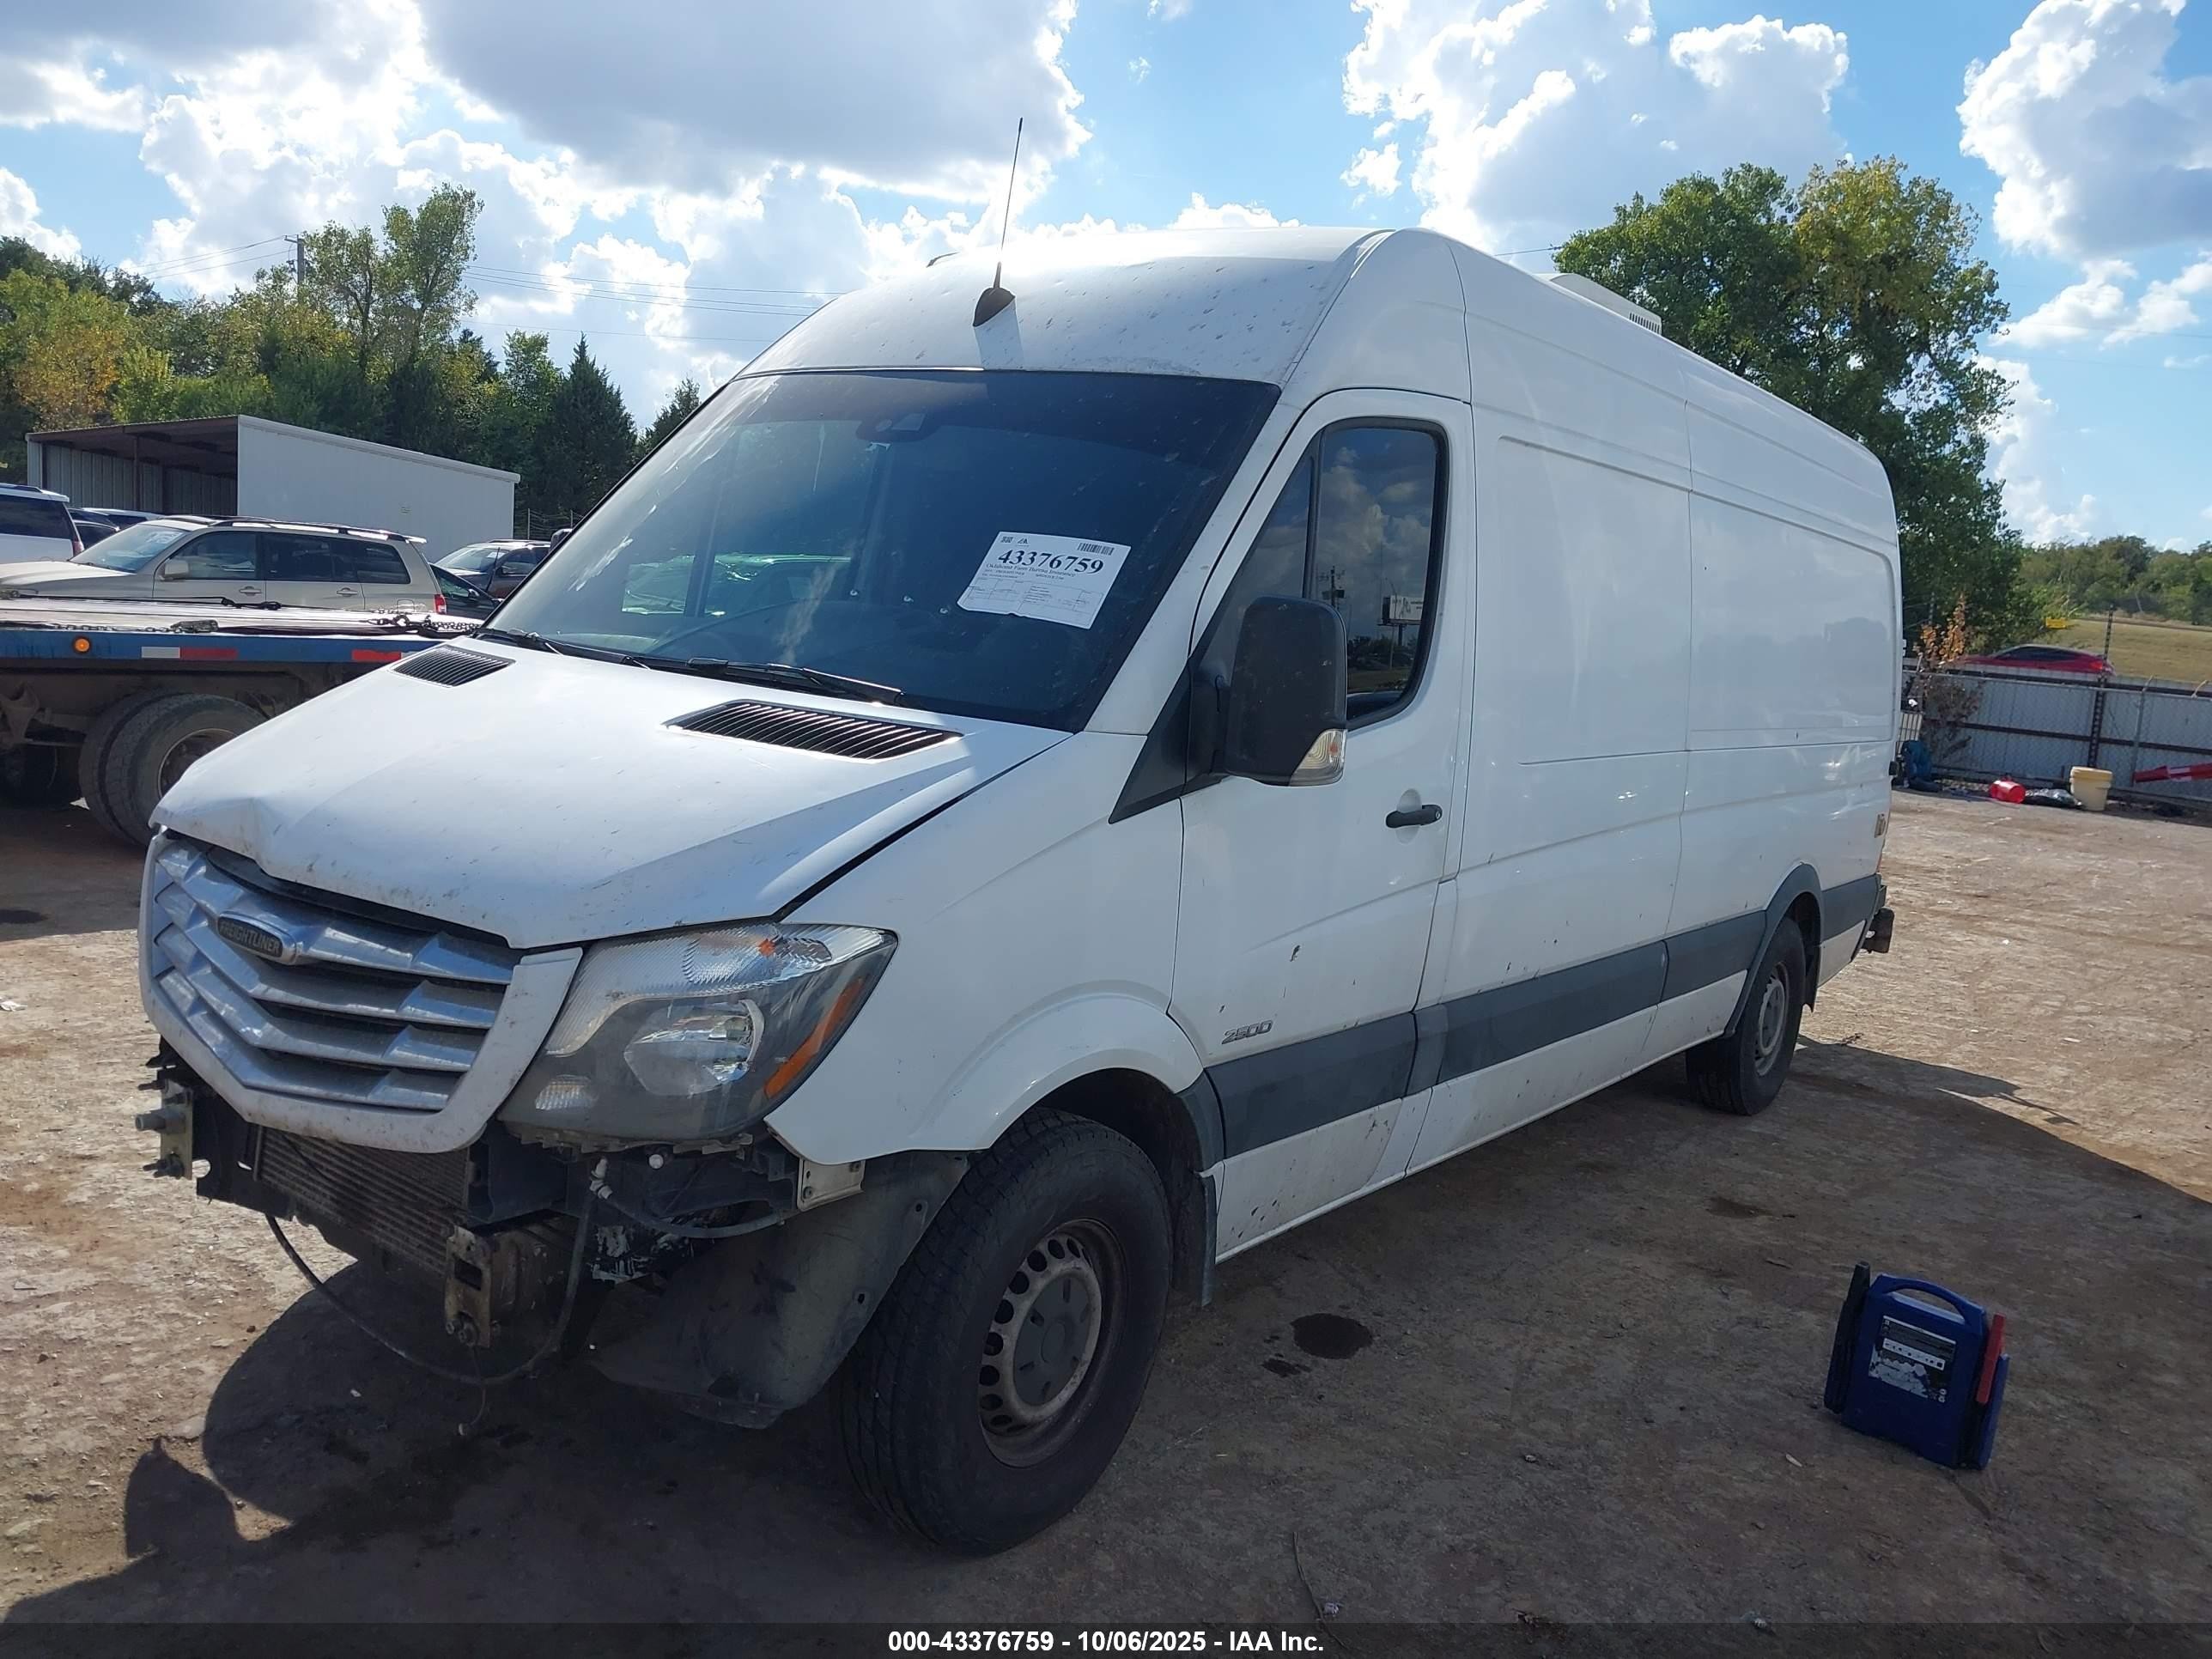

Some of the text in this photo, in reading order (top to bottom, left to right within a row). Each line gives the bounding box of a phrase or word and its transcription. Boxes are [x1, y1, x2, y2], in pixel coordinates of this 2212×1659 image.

[998, 549, 1104, 574] 43376759
[220, 921, 280, 954] FREIGHTLINER
[1221, 1019, 1273, 1045] 2500
